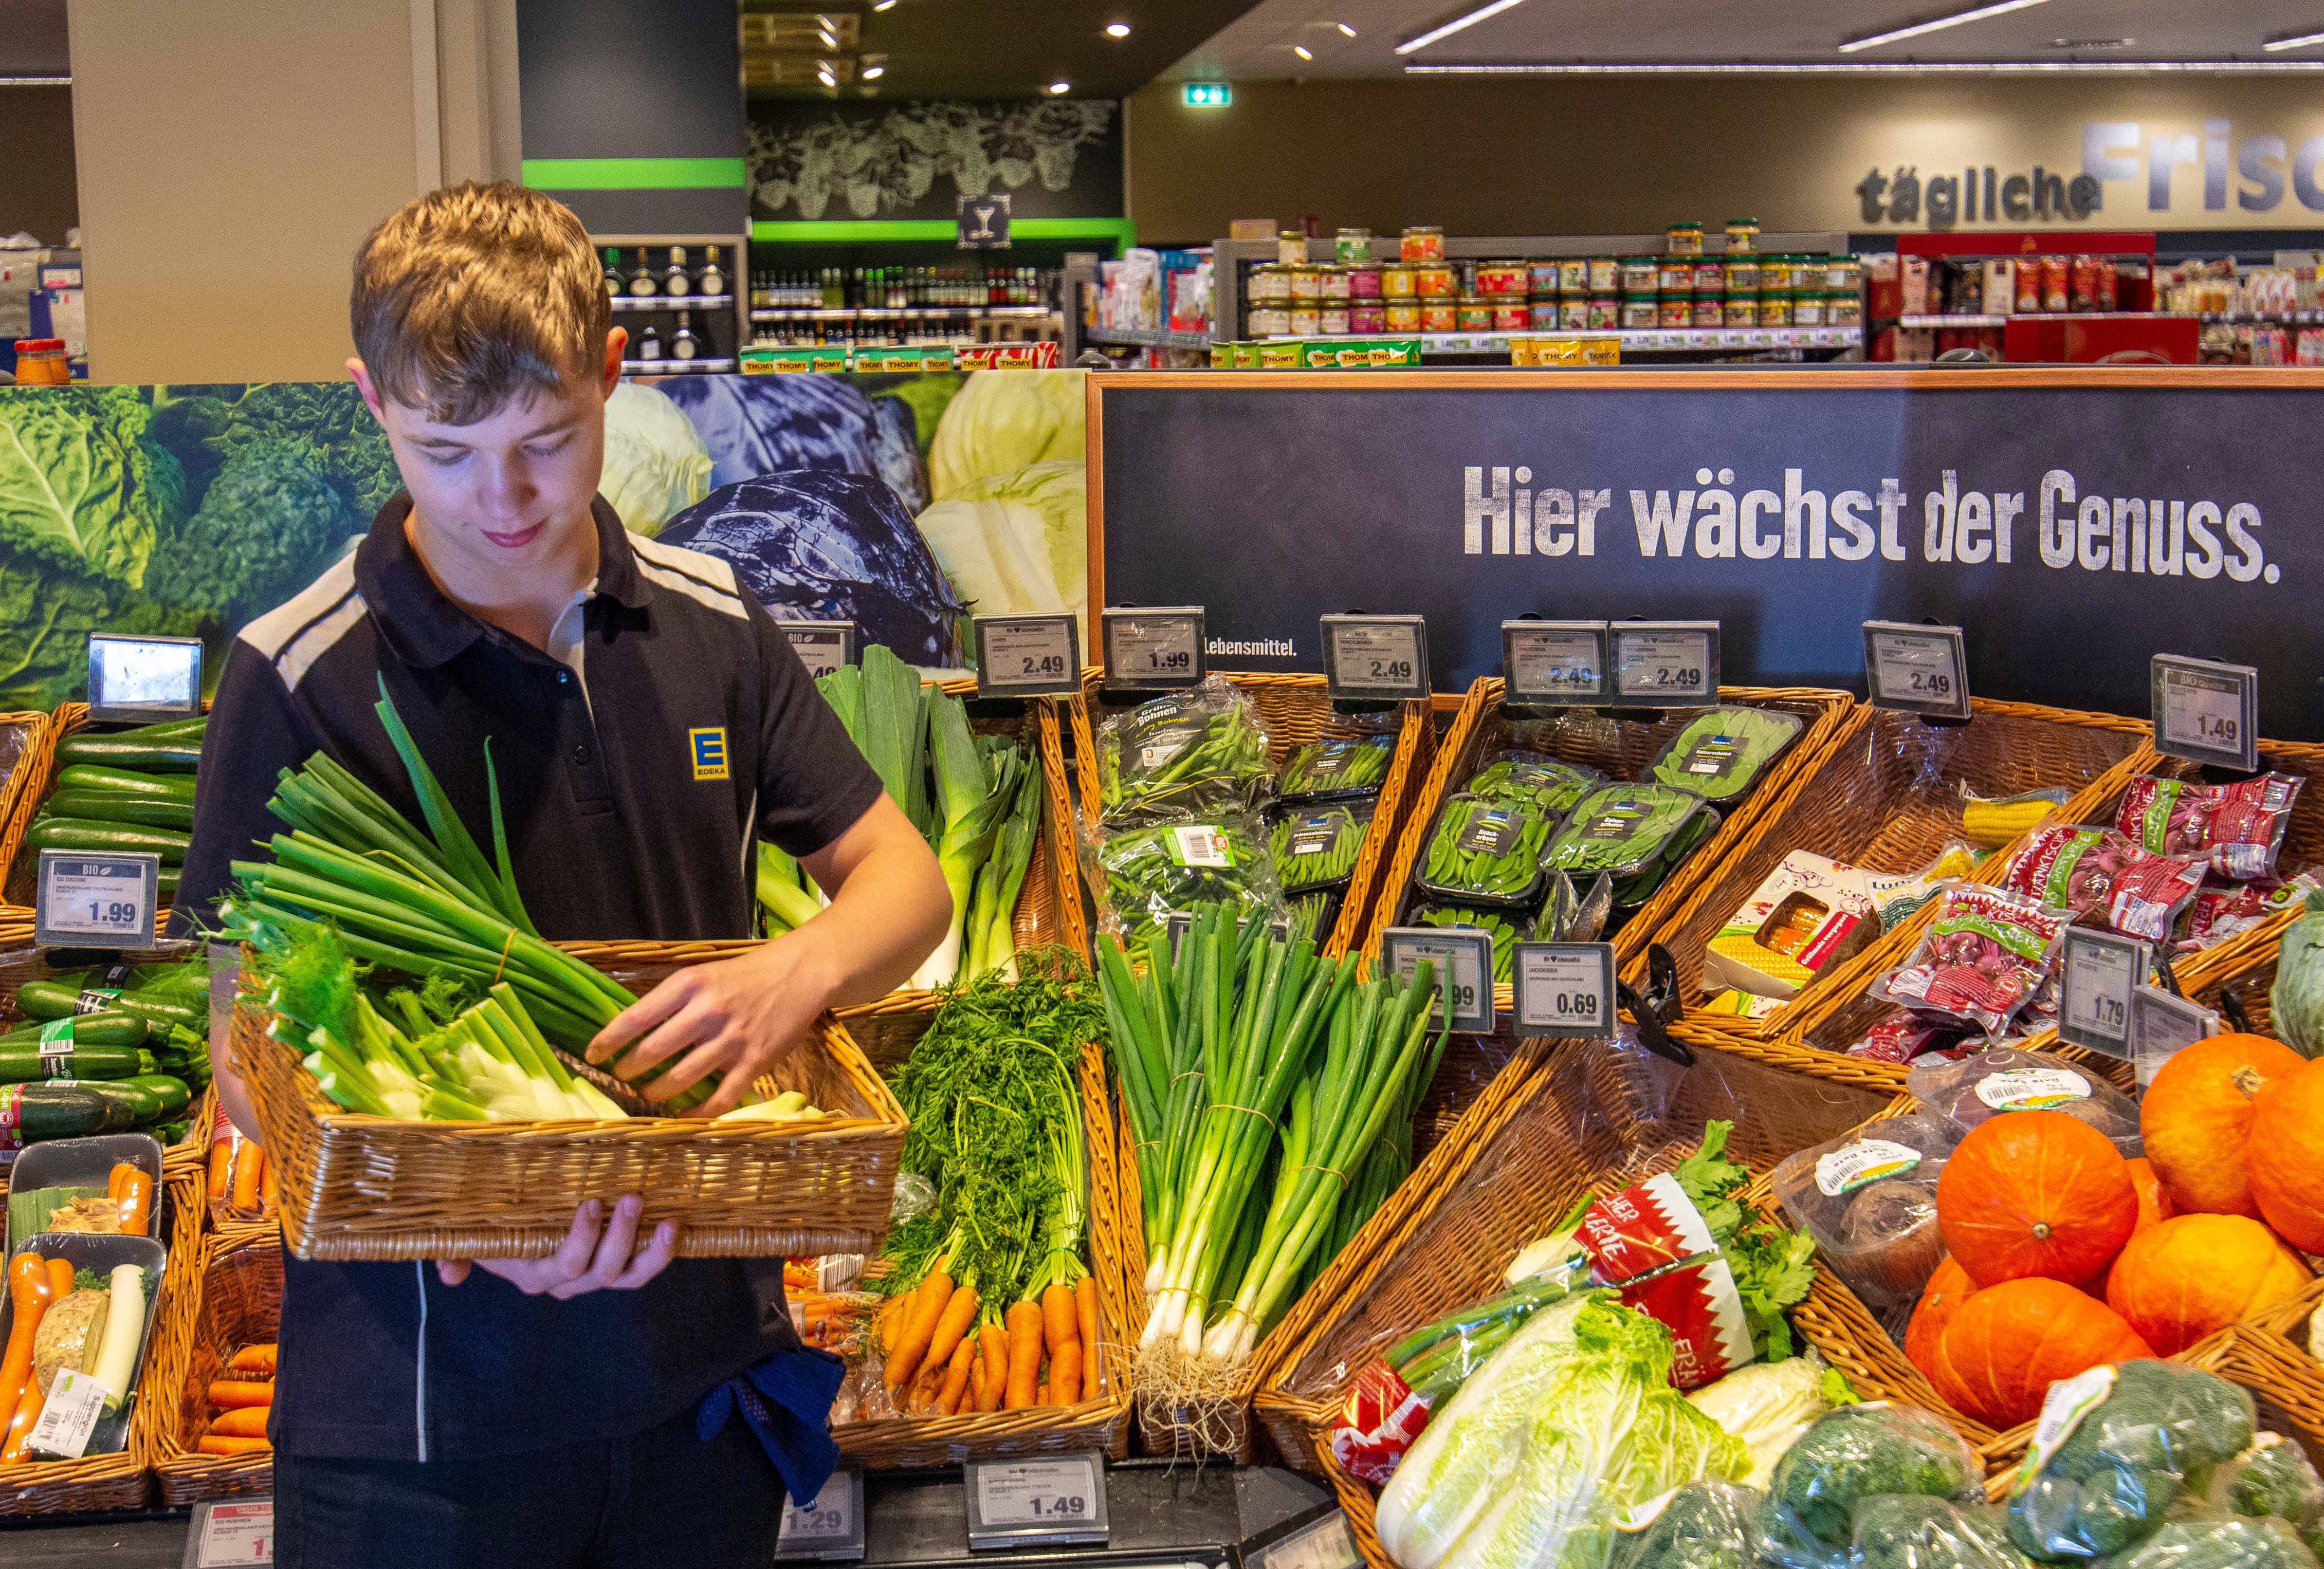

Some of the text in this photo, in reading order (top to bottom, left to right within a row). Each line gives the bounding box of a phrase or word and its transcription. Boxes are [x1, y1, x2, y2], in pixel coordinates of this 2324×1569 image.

[1464, 464, 2281, 585] Hier wächst der Genuss.
[787, 633, 803, 643] BIO
[1205, 637, 1297, 657] Lebensmittel.
[1023, 656, 1064, 674] 2.49
[1149, 651, 1189, 667] 1.99
[1371, 661, 1411, 678] 2.49
[1550, 667, 1592, 683] 2.49
[1657, 668, 1701, 685] 2.49
[1911, 672, 1950, 693] 2.49
[1137, 707, 1177, 727] Bohnen
[1157, 717, 1190, 726] Bohnen
[2198, 715, 2237, 740] 1.49
[82, 864, 98, 875] BIO
[89, 902, 136, 923] 1.99
[1557, 993, 1597, 1014] 0.69
[2094, 996, 2124, 1026] 1.79
[1605, 1194, 1640, 1223] HER
[78, 1394, 101, 1437] Suppengrün
[1030, 1496, 1085, 1514] 1.49
[787, 1510, 842, 1530] 1.29
